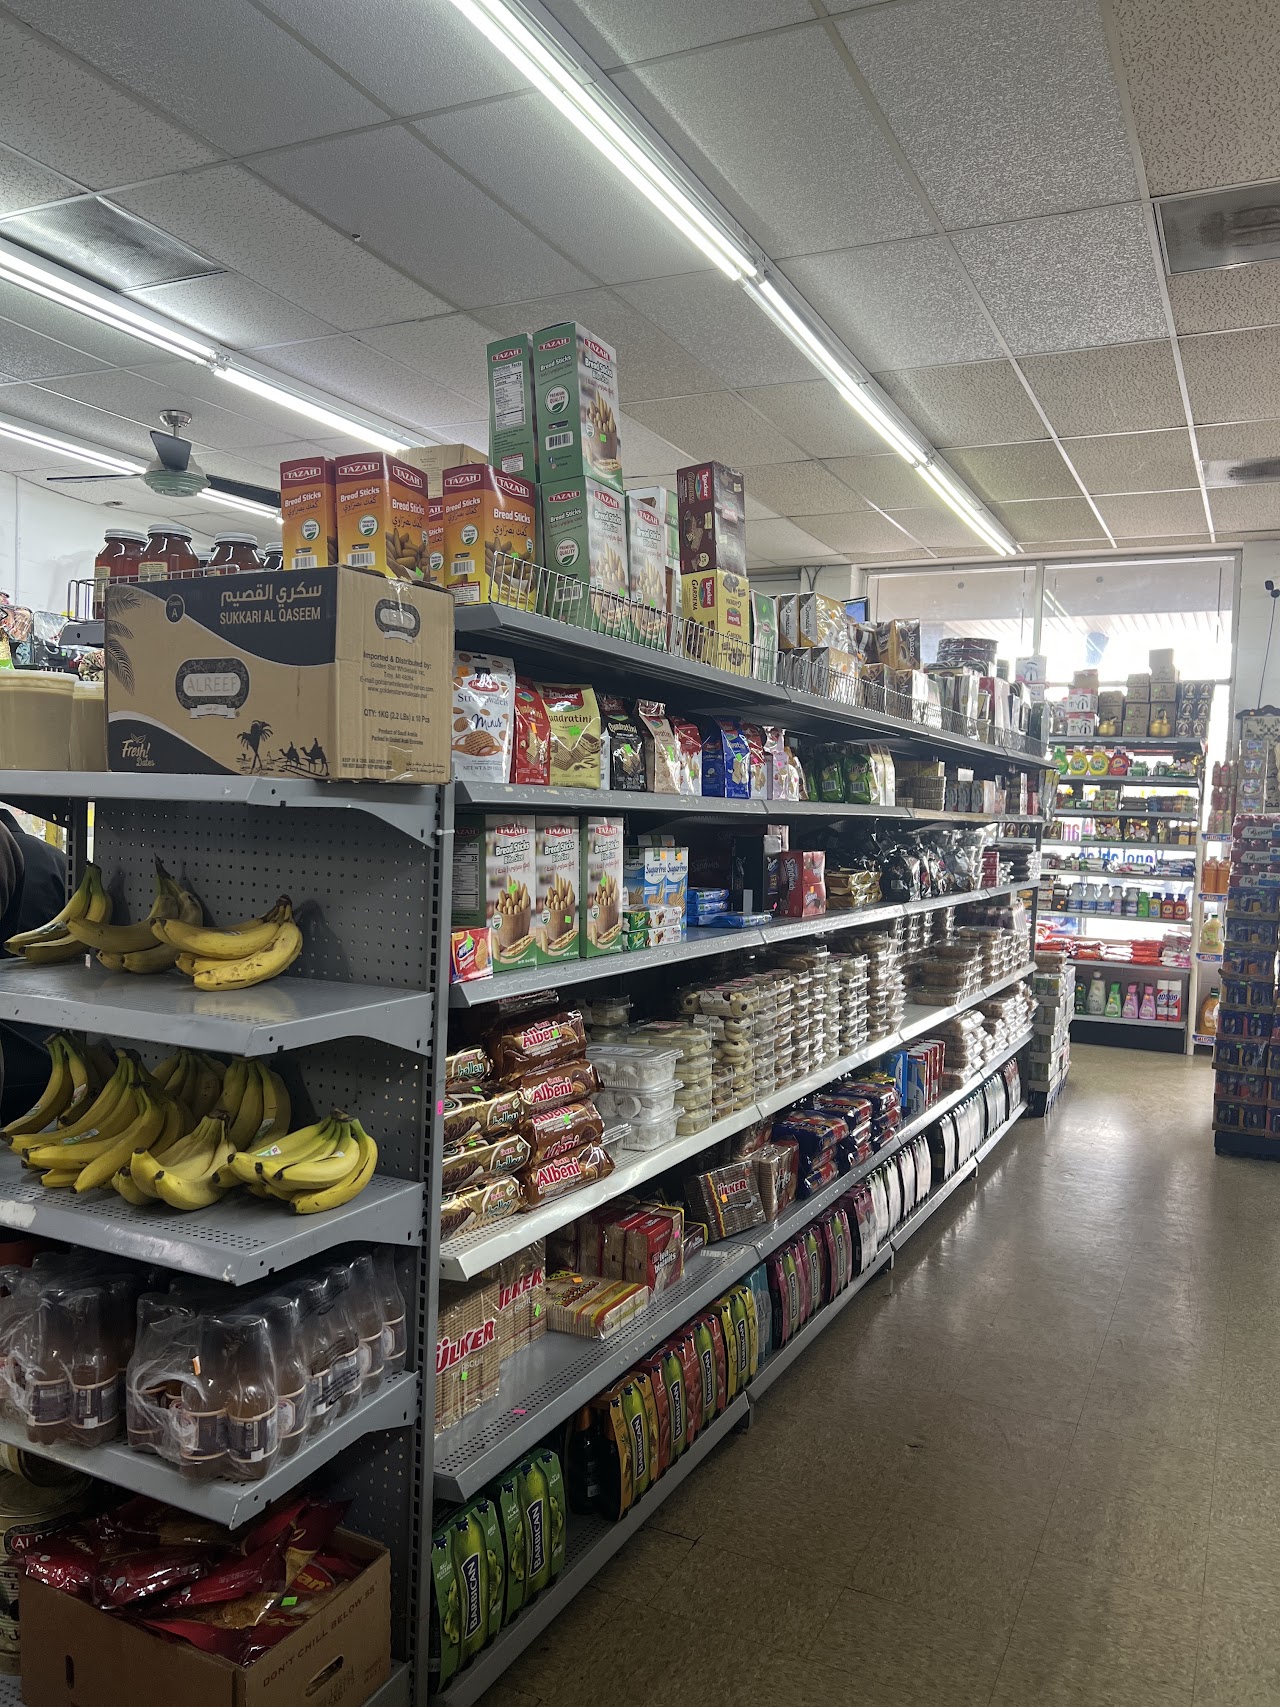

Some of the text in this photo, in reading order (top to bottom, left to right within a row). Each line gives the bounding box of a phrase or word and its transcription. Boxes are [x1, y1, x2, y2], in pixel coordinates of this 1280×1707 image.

[541, 338, 569, 350] TAZAH
[585, 339, 610, 361] TAZAH
[494, 349, 520, 360] TAZAH
[540, 355, 571, 371] Bread Sticks
[287, 469, 317, 478] TAZAH
[343, 464, 375, 473] TAZAH
[397, 469, 420, 486] TAZAH
[449, 474, 477, 485] TAZAH
[340, 487, 380, 502] Bread Sticks
[500, 478, 526, 495] TAZAH
[284, 491, 321, 507] Bread Sticks
[551, 491, 578, 501] TAZAH
[596, 491, 619, 509] TAZAH
[392, 499, 425, 515] Bread Sticks
[446, 497, 481, 513] Bread Sticks
[494, 508, 531, 524] Bread Sticks
[550, 508, 582, 523] Bread Sticks
[594, 510, 622, 525] Bread Sticks
[639, 510, 659, 525] TAZAH
[636, 528, 661, 541] Bread Sticks
[221, 582, 322, 607] سكري القصيم
[172, 608, 178, 618] A
[220, 607, 321, 625] SUKKARI AL QASEEM
[363, 651, 389, 662] Imported
[395, 656, 423, 668] Distributed
[423, 661, 431, 670] by:
[186, 676, 237, 693] ALREEF
[363, 709, 377, 717] QTY:
[390, 711, 399, 720] (2.2
[471, 713, 503, 730] Minis
[549, 714, 592, 724] uadratini
[122, 739, 151, 758] Fresh!
[136, 757, 155, 767] Dates
[500, 827, 525, 835] TAZAH
[549, 827, 571, 835] TAZAH
[495, 840, 530, 856] Bread Sticks
[545, 840, 574, 855] Bread Sticks
[595, 840, 619, 854] Bread Sticks
[504, 853, 524, 864] Bite Size
[785, 859, 796, 890] Sandwich
[458, 1061, 484, 1077] halley
[532, 1077, 572, 1104] Albeni
[537, 1158, 580, 1187] Albeni
[718, 1179, 747, 1196] ÜLKER
[549, 1272, 570, 1280] PACK
[436, 1320, 495, 1374] ÜLKER
[635, 1420, 644, 1473] BARBICAN
[532, 1506, 541, 1569] BARBICAN
[467, 1561, 478, 1630] BARBICAN
[264, 1656, 294, 1687] DON'T
[298, 1630, 328, 1658] CHILL
[331, 1597, 362, 1629] BELOW
